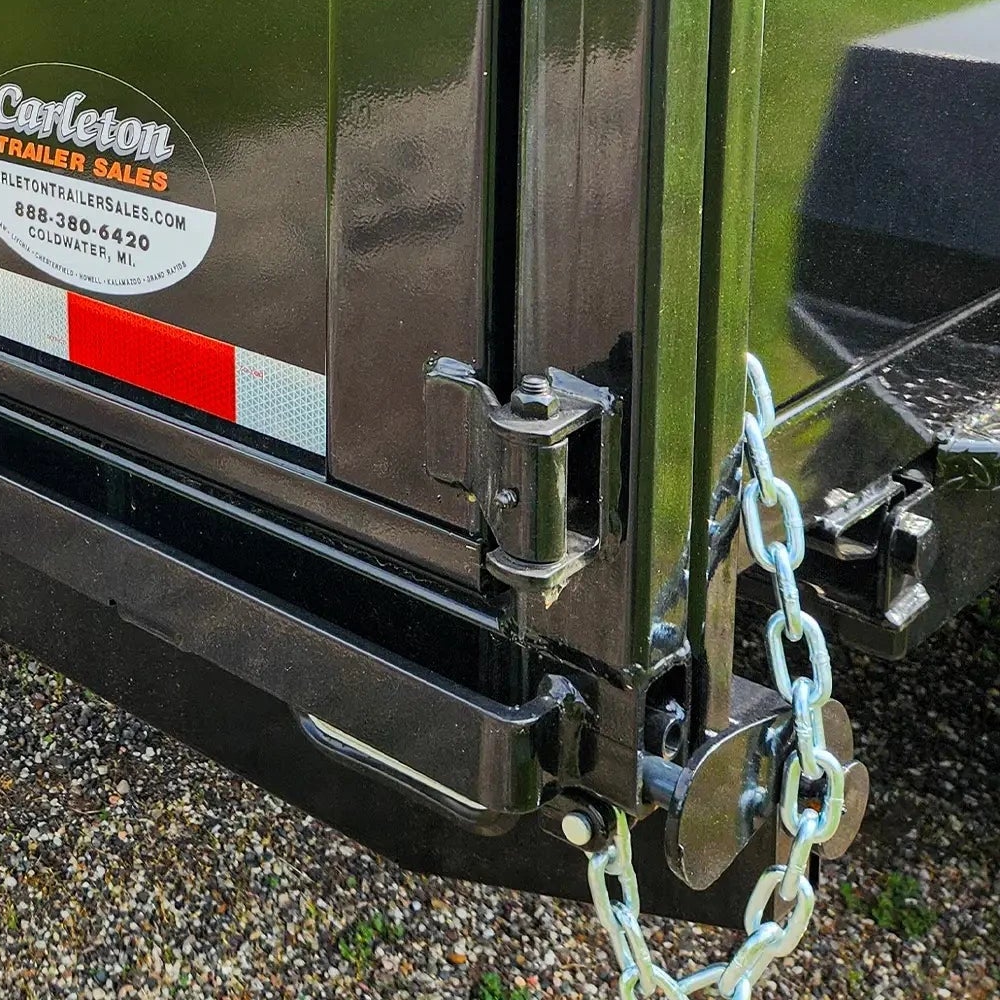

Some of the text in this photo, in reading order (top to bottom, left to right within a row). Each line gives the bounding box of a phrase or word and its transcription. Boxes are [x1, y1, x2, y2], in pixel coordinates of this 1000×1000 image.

[92, 156, 168, 192] SALES
[14, 201, 150, 252] 888-380-6420
[28, 226, 136, 267] COLDWATER, MI.
[79, 272, 102, 285] HOWELL
[107, 276, 142, 286] KALAMAZOO
